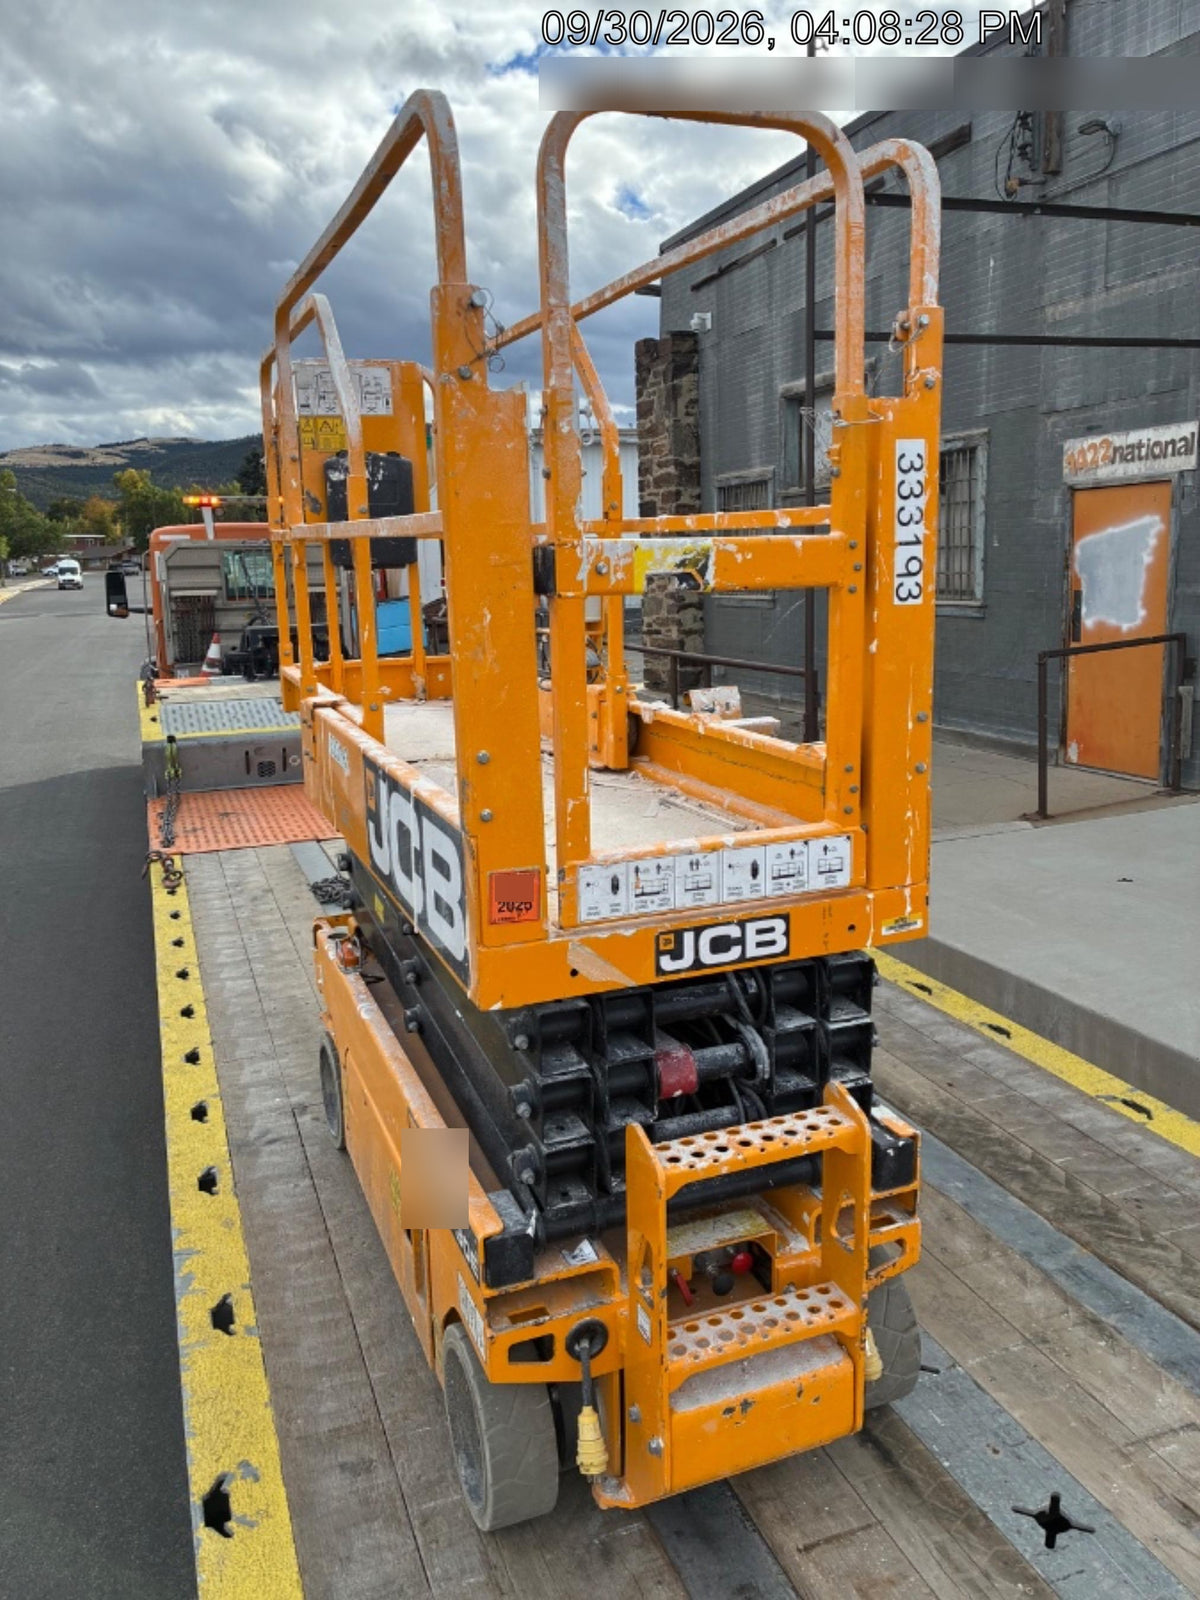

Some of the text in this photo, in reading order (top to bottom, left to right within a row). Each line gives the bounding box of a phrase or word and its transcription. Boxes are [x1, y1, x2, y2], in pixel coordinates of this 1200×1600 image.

[896, 452, 924, 602] 333193
[368, 769, 465, 962] JCB
[658, 918, 788, 972] JCB
